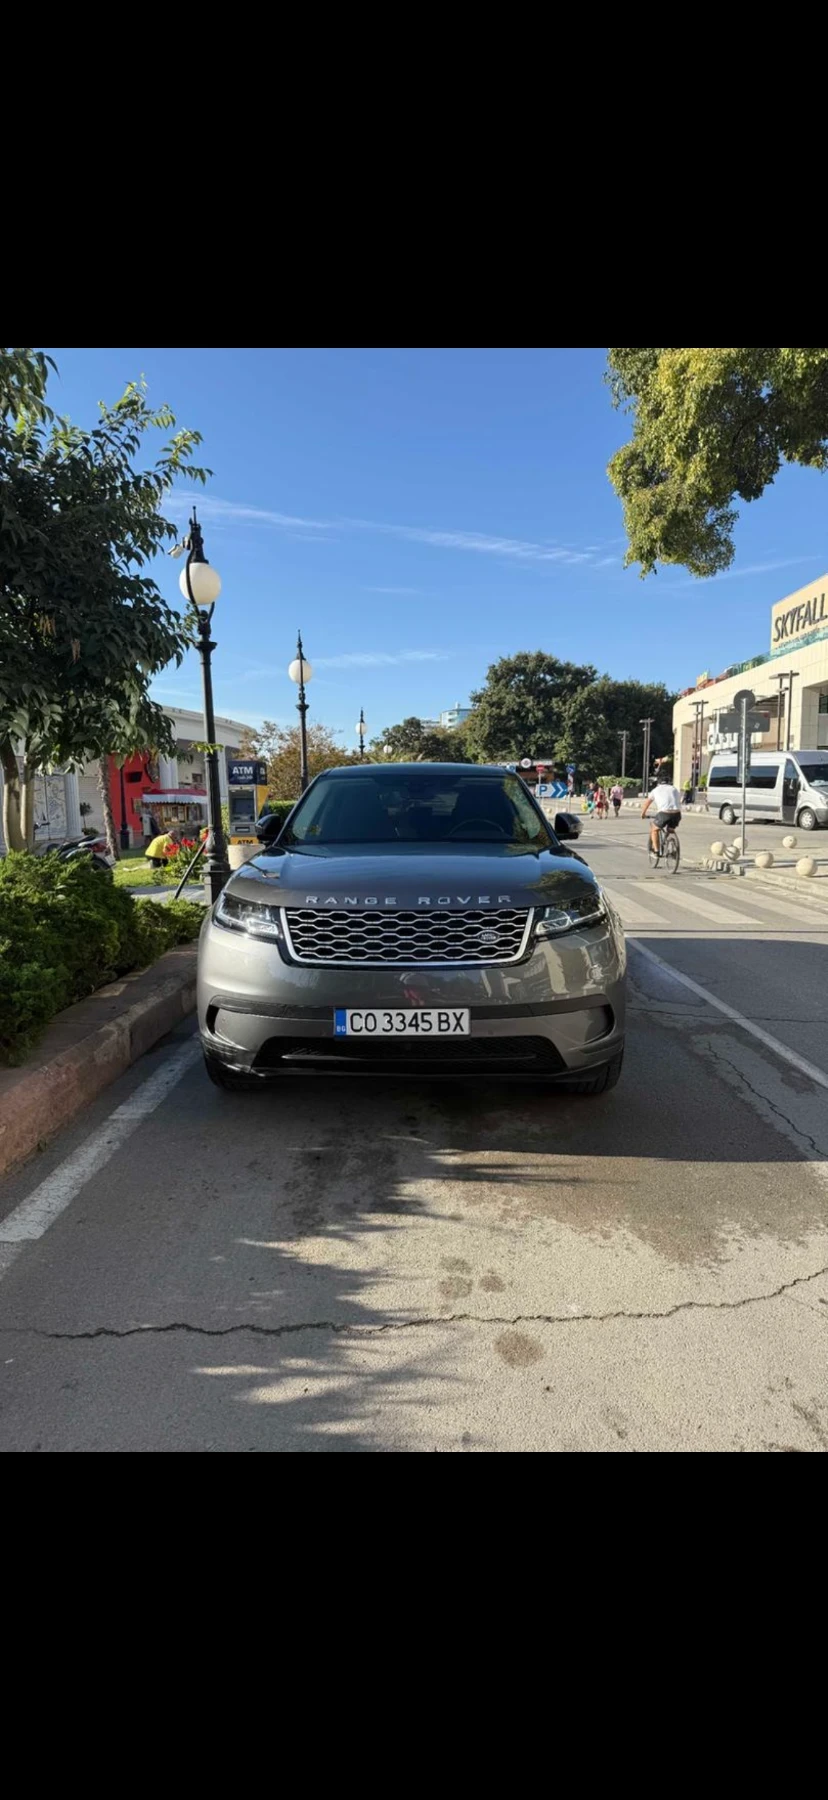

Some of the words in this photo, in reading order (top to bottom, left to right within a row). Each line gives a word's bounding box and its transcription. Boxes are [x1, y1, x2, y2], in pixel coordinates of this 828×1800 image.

[773, 593, 828, 642] SKYFALL
[232, 766, 253, 775] ATM
[539, 785, 548, 795] P
[305, 895, 397, 905] RANGE
[418, 895, 511, 905] ROVER
[350, 1012, 377, 1033] CO
[381, 1012, 433, 1033] 3345
[438, 1011, 465, 1032] BX
[336, 1025, 346, 1033] BG
